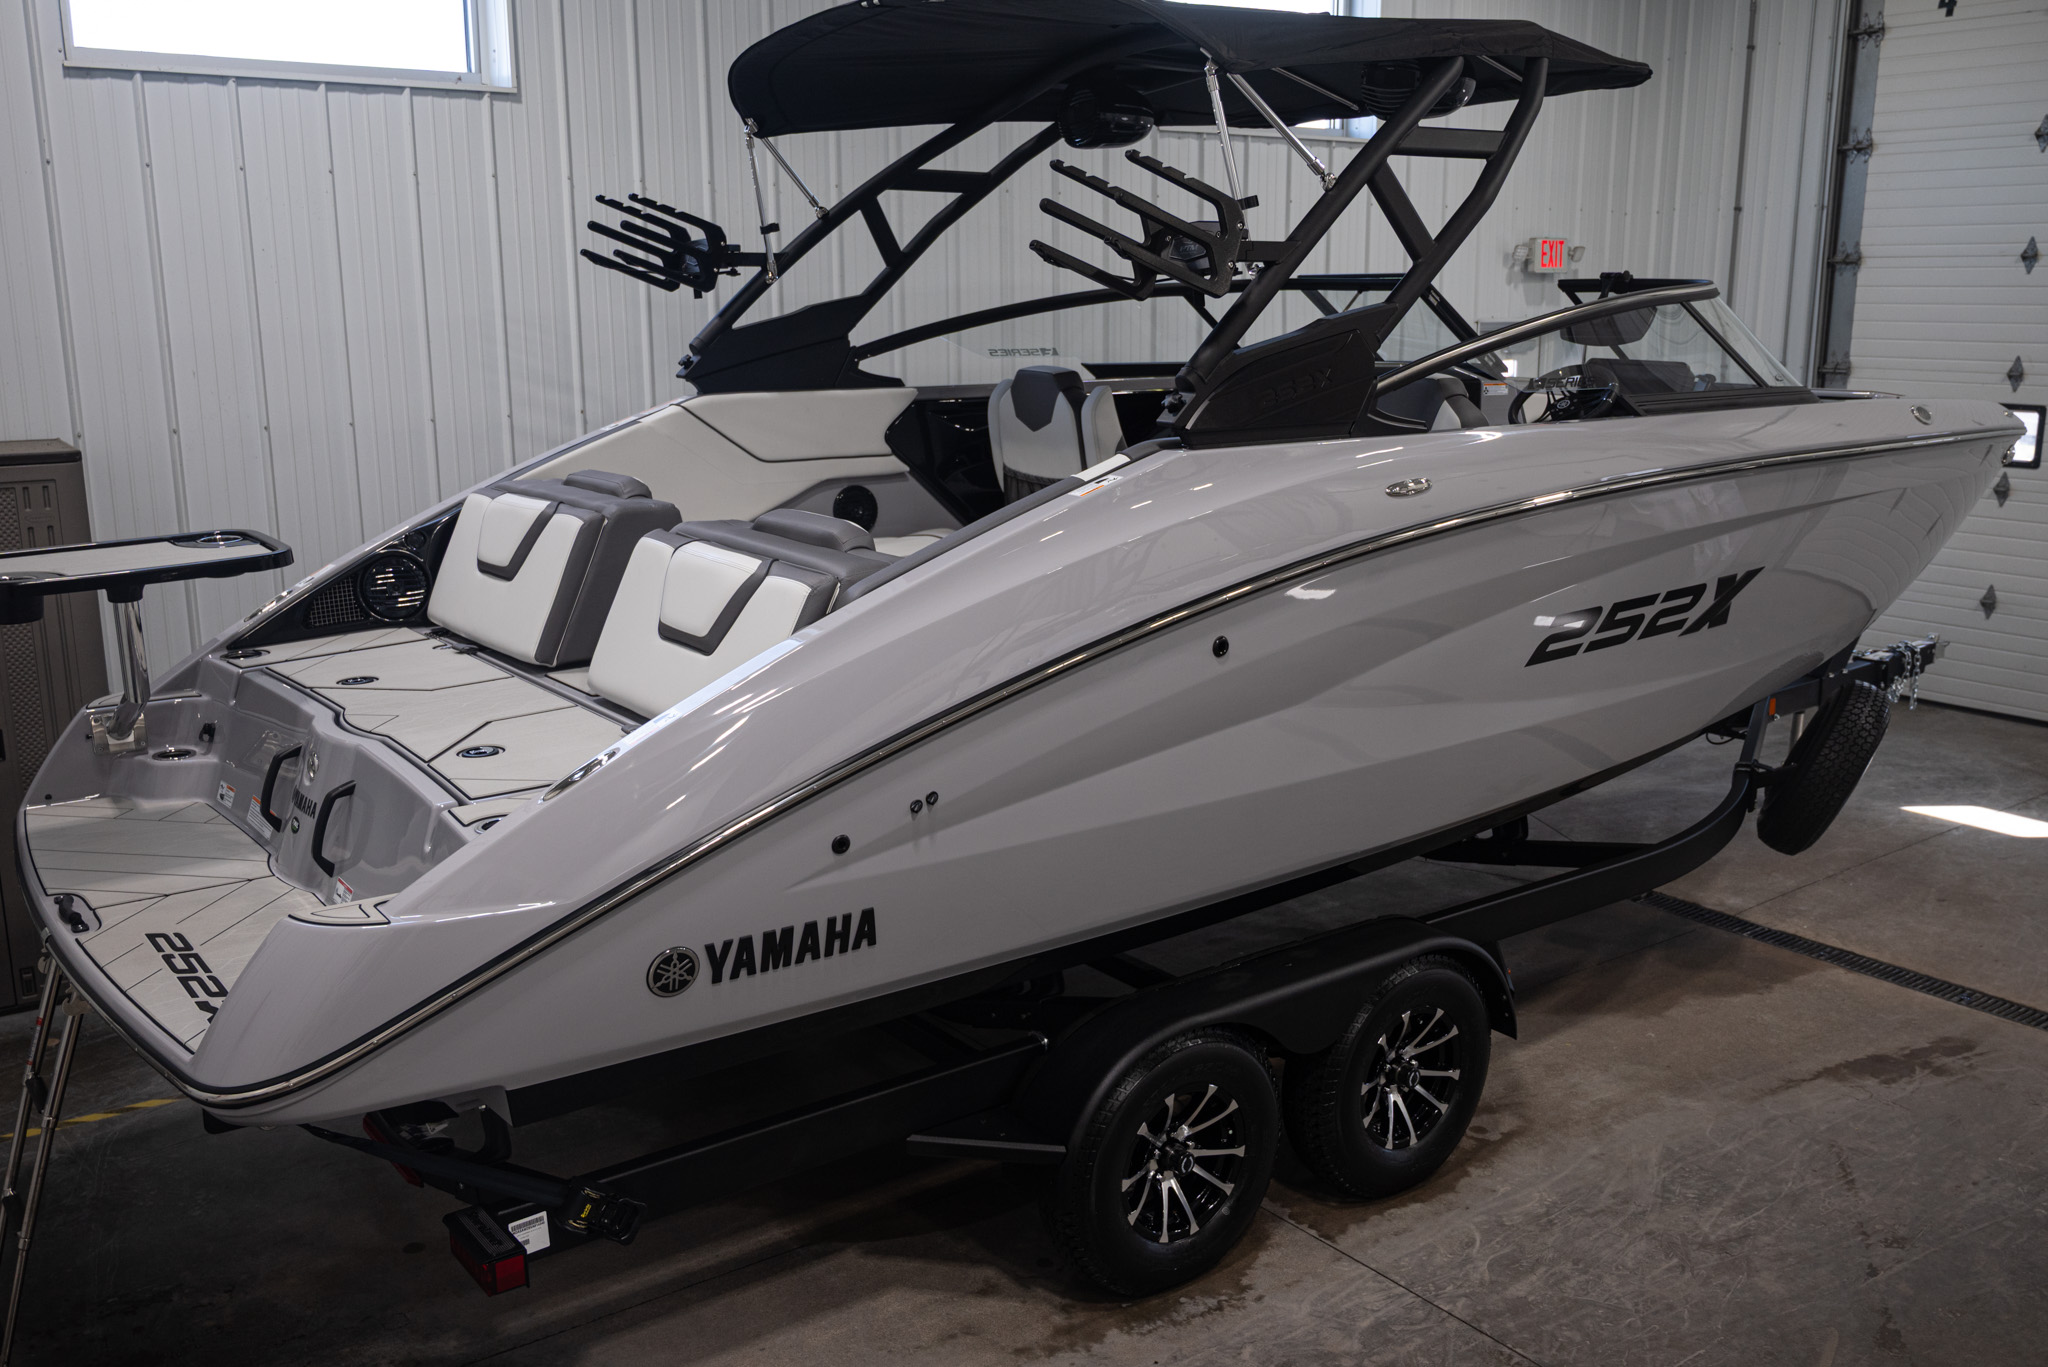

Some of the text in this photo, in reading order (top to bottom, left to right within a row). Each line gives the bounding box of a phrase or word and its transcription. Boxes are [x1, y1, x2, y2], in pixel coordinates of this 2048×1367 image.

[1541, 240, 1564, 268] EXIT
[1524, 566, 1766, 668] 252X
[292, 785, 317, 819] YAMAHA
[704, 907, 877, 985] YAMAHA
